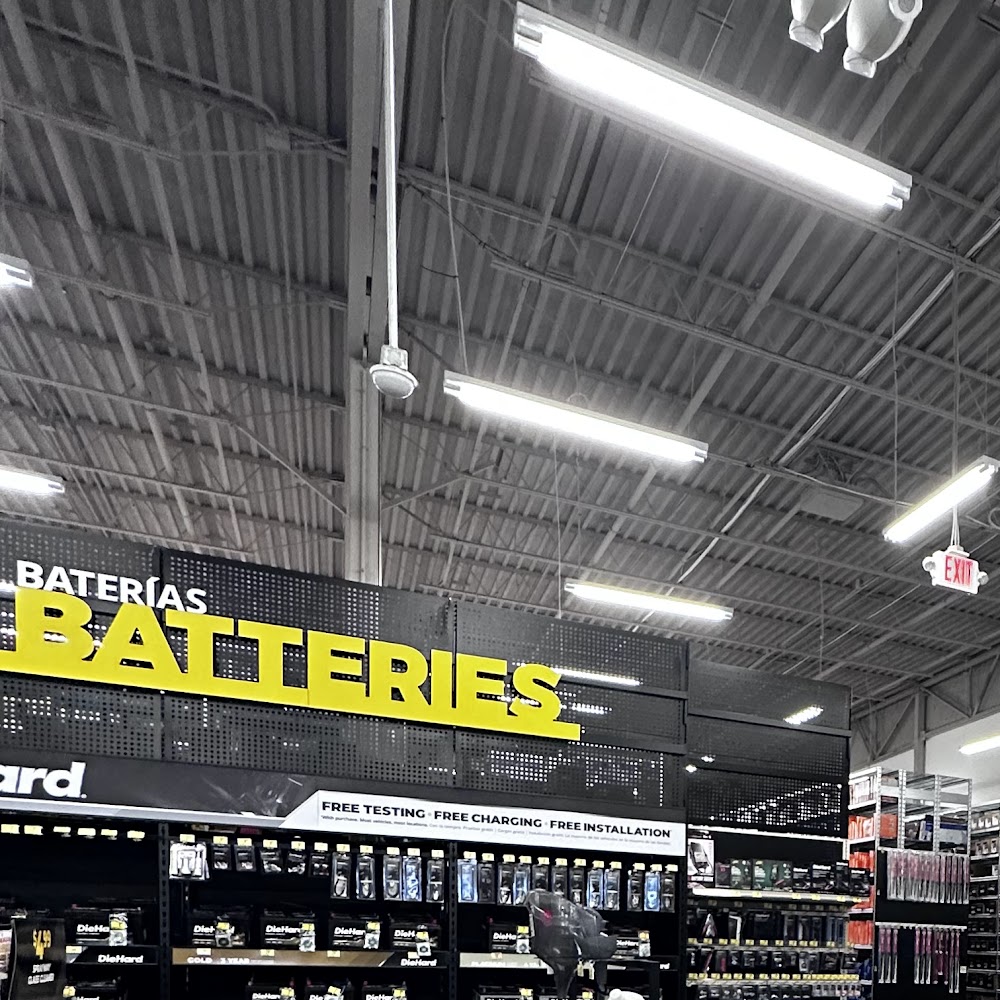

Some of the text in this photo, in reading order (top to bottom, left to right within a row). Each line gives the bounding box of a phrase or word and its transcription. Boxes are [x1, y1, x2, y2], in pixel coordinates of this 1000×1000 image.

[16, 560, 207, 614] BATERÍAS
[944, 555, 973, 587] EXIT
[14, 588, 564, 722] BATTERIES
[322, 801, 360, 814] FREE
[363, 804, 426, 819] TESTING
[434, 810, 469, 822] FREE
[472, 813, 542, 828] CHARGING
[550, 819, 581, 831] FREE
[584, 821, 672, 839] INSTALLATION
[97, 954, 144, 964] DieHard
[401, 958, 437, 967] DieHard
